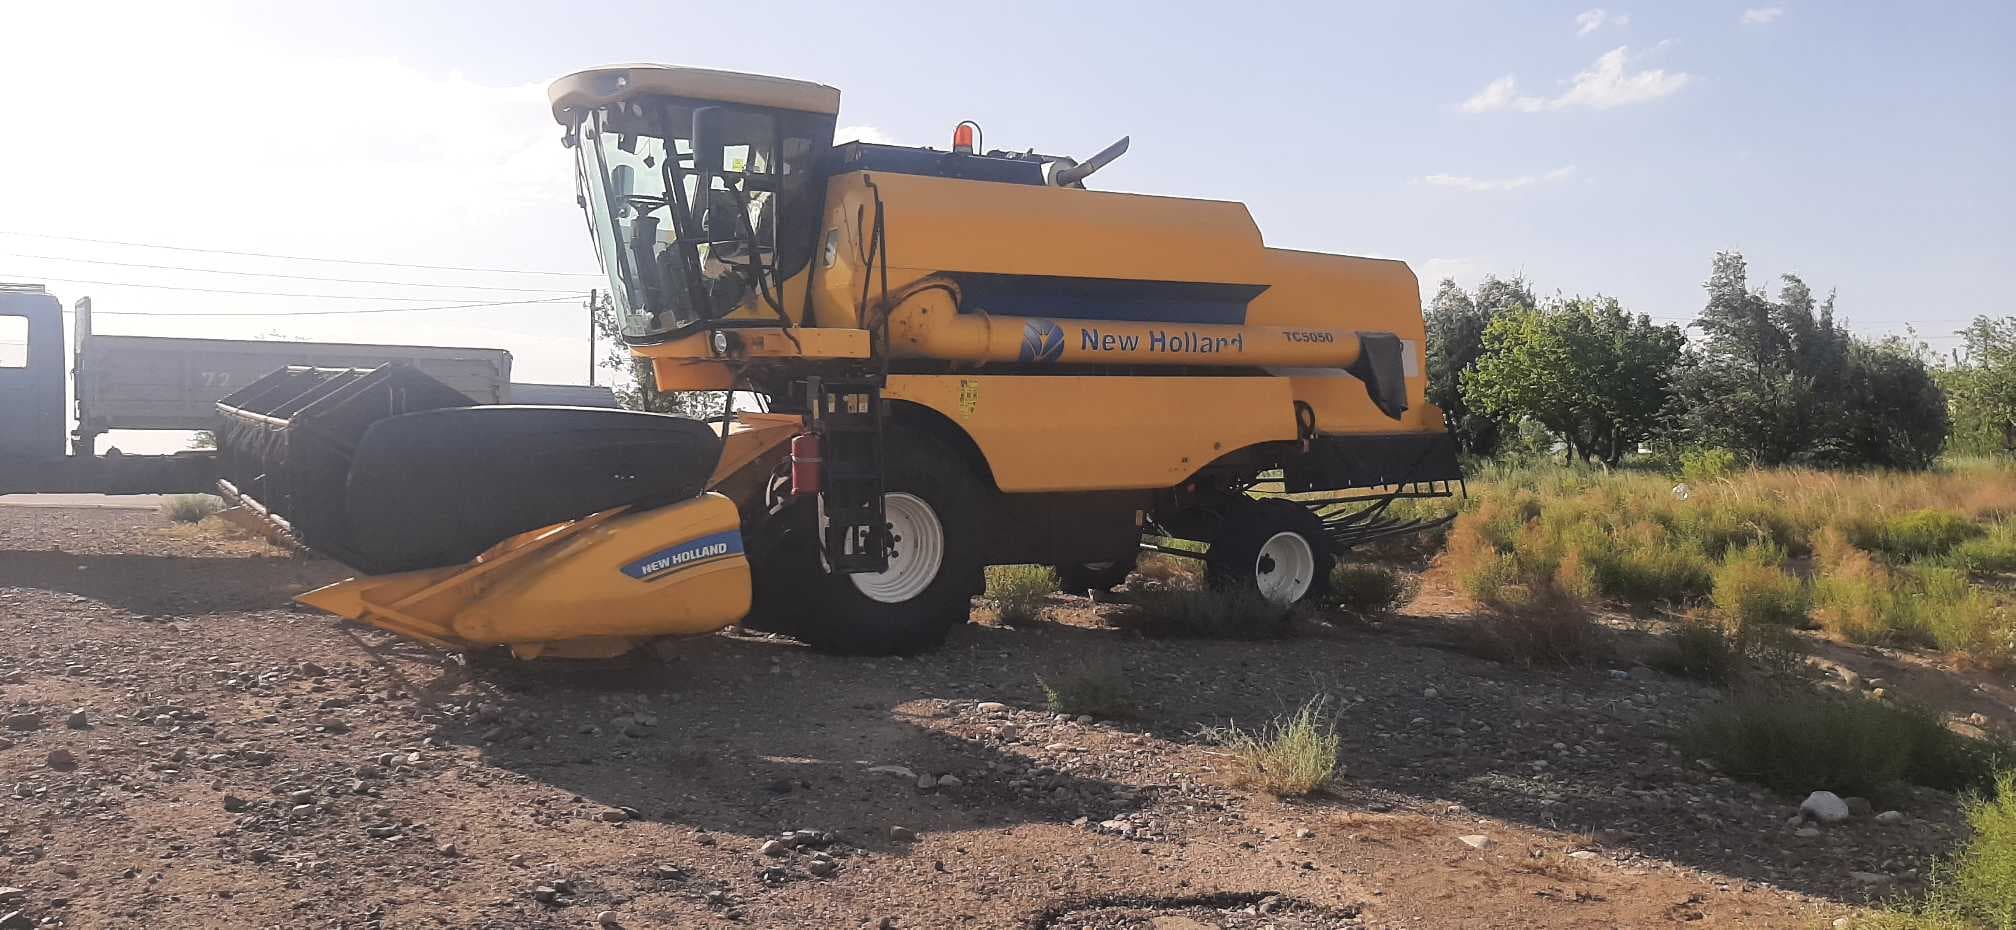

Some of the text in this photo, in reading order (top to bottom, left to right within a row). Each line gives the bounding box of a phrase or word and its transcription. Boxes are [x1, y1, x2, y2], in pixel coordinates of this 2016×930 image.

[1080, 327, 1244, 354] New Holland
[1282, 330, 1334, 343] TC5050
[641, 542, 728, 575] NEW HOLLAND
